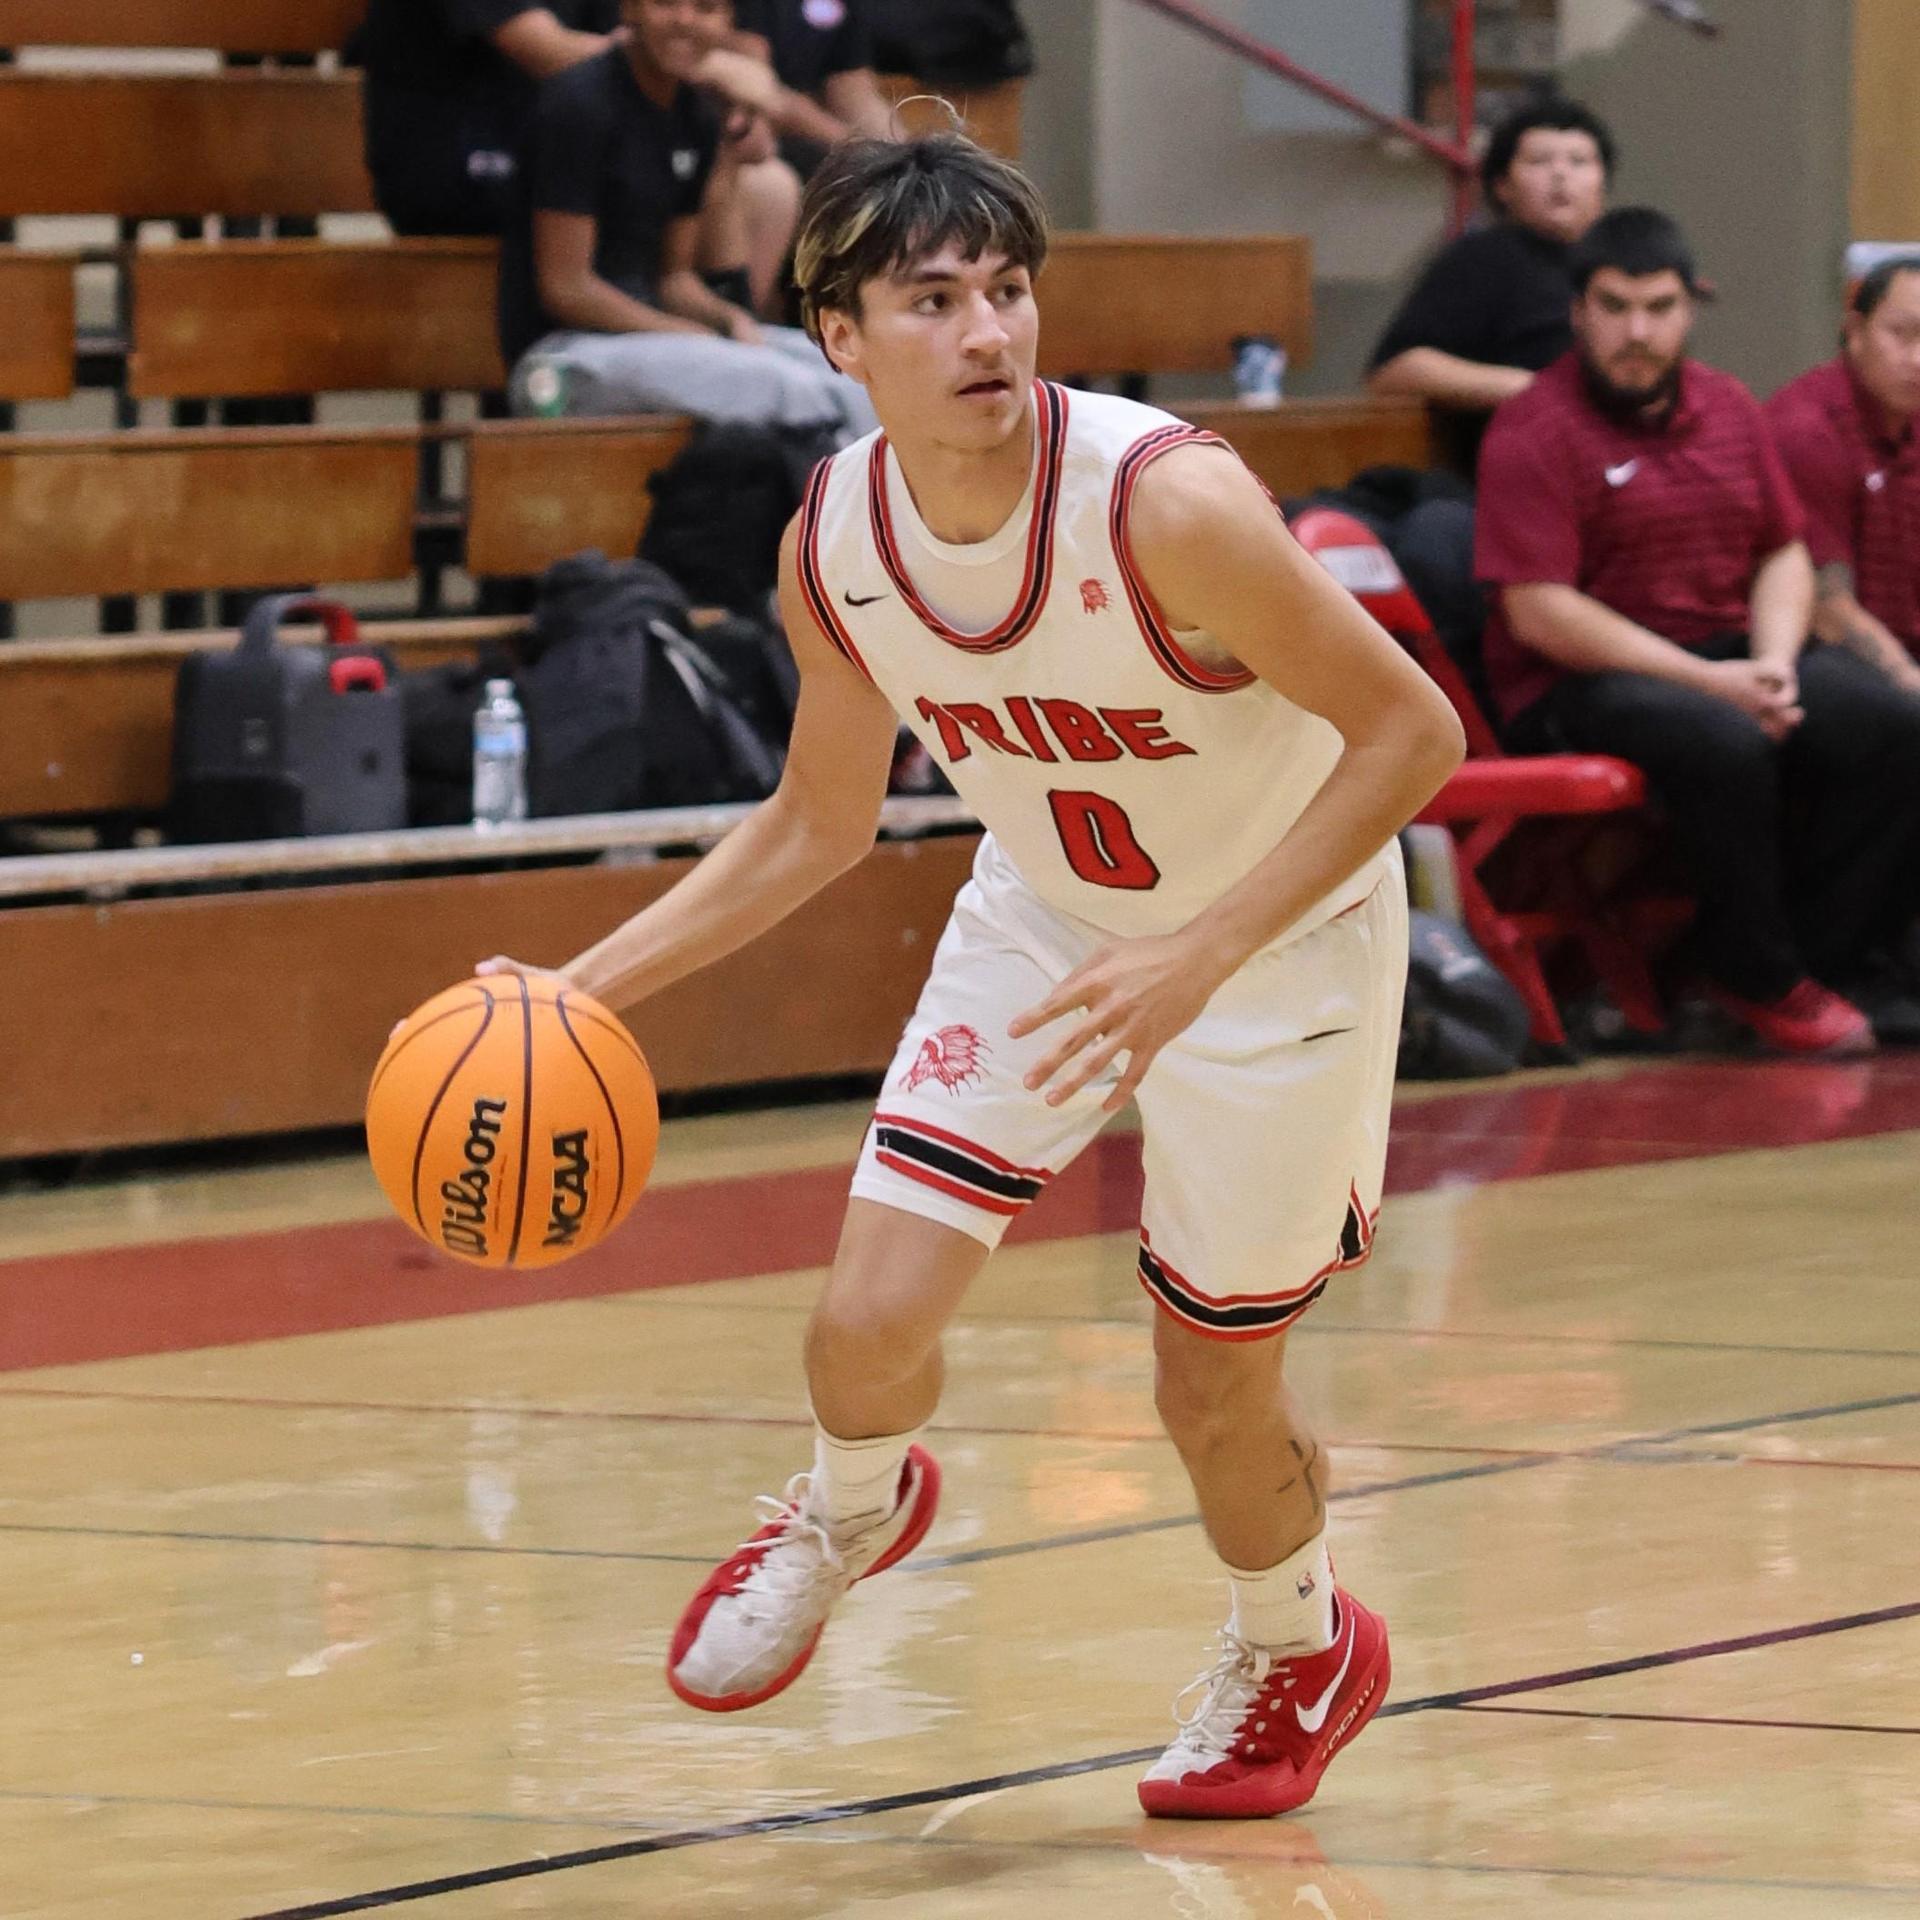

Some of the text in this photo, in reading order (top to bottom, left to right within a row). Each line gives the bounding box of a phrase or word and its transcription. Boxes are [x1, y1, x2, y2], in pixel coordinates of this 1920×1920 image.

[914, 696, 1198, 763] TRIBE
[1047, 789, 1161, 891] 0
[441, 1098, 507, 1256] Wilson
[542, 1130, 590, 1246] NCAA
